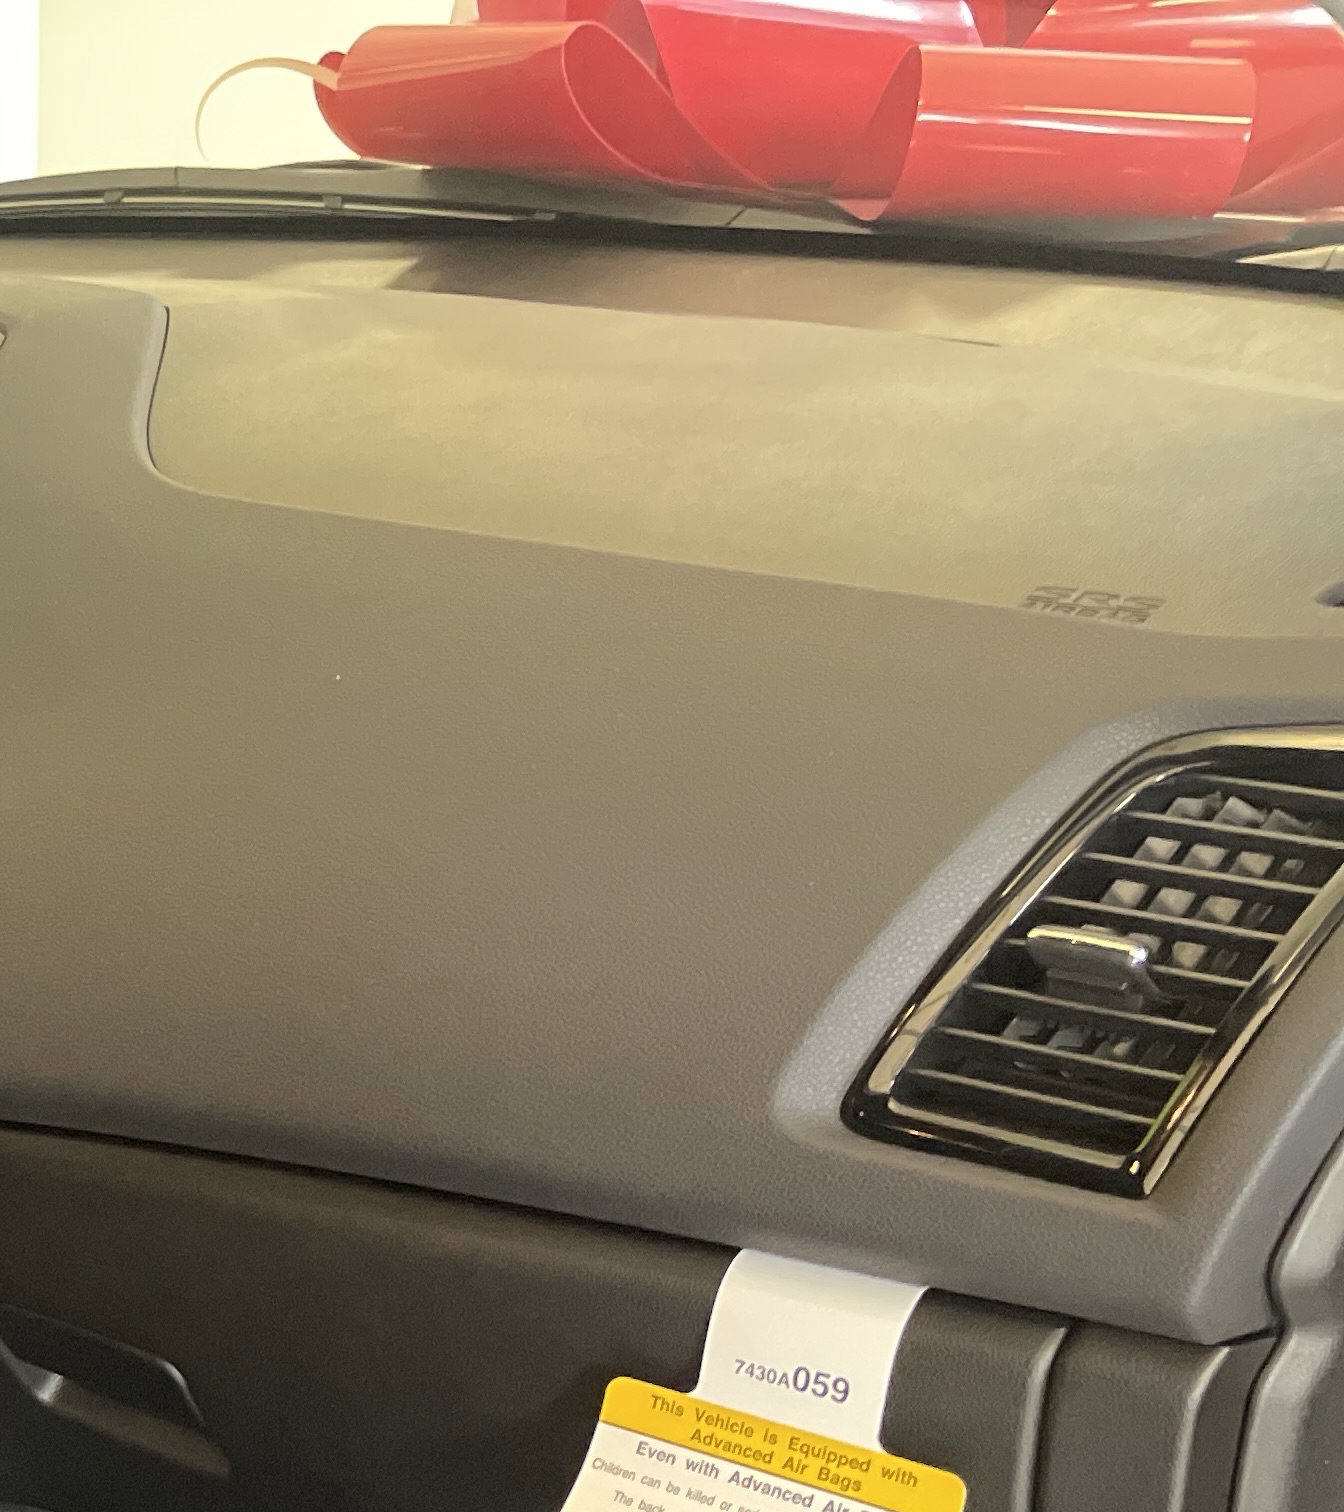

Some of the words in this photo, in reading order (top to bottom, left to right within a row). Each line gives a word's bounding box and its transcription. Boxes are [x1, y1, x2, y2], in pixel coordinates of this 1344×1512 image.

[734, 1358, 850, 1404] 7430A059
[651, 1394, 685, 1417] This
[695, 1407, 755, 1438] Vehicle
[787, 1436, 872, 1473] Equipped
[880, 1465, 919, 1488] with
[689, 1428, 774, 1465] Advanced
[781, 1455, 810, 1475] Air
[816, 1466, 863, 1493] Bags
[591, 1456, 636, 1481] Children
[640, 1474, 662, 1489] can
[665, 1481, 681, 1496] be
[685, 1487, 716, 1507] killed
[718, 1499, 733, 1512] or
[613, 1489, 634, 1507] The
[636, 1440, 676, 1466] Even
[685, 1457, 720, 1480] with
[728, 1468, 815, 1508] Advanced
